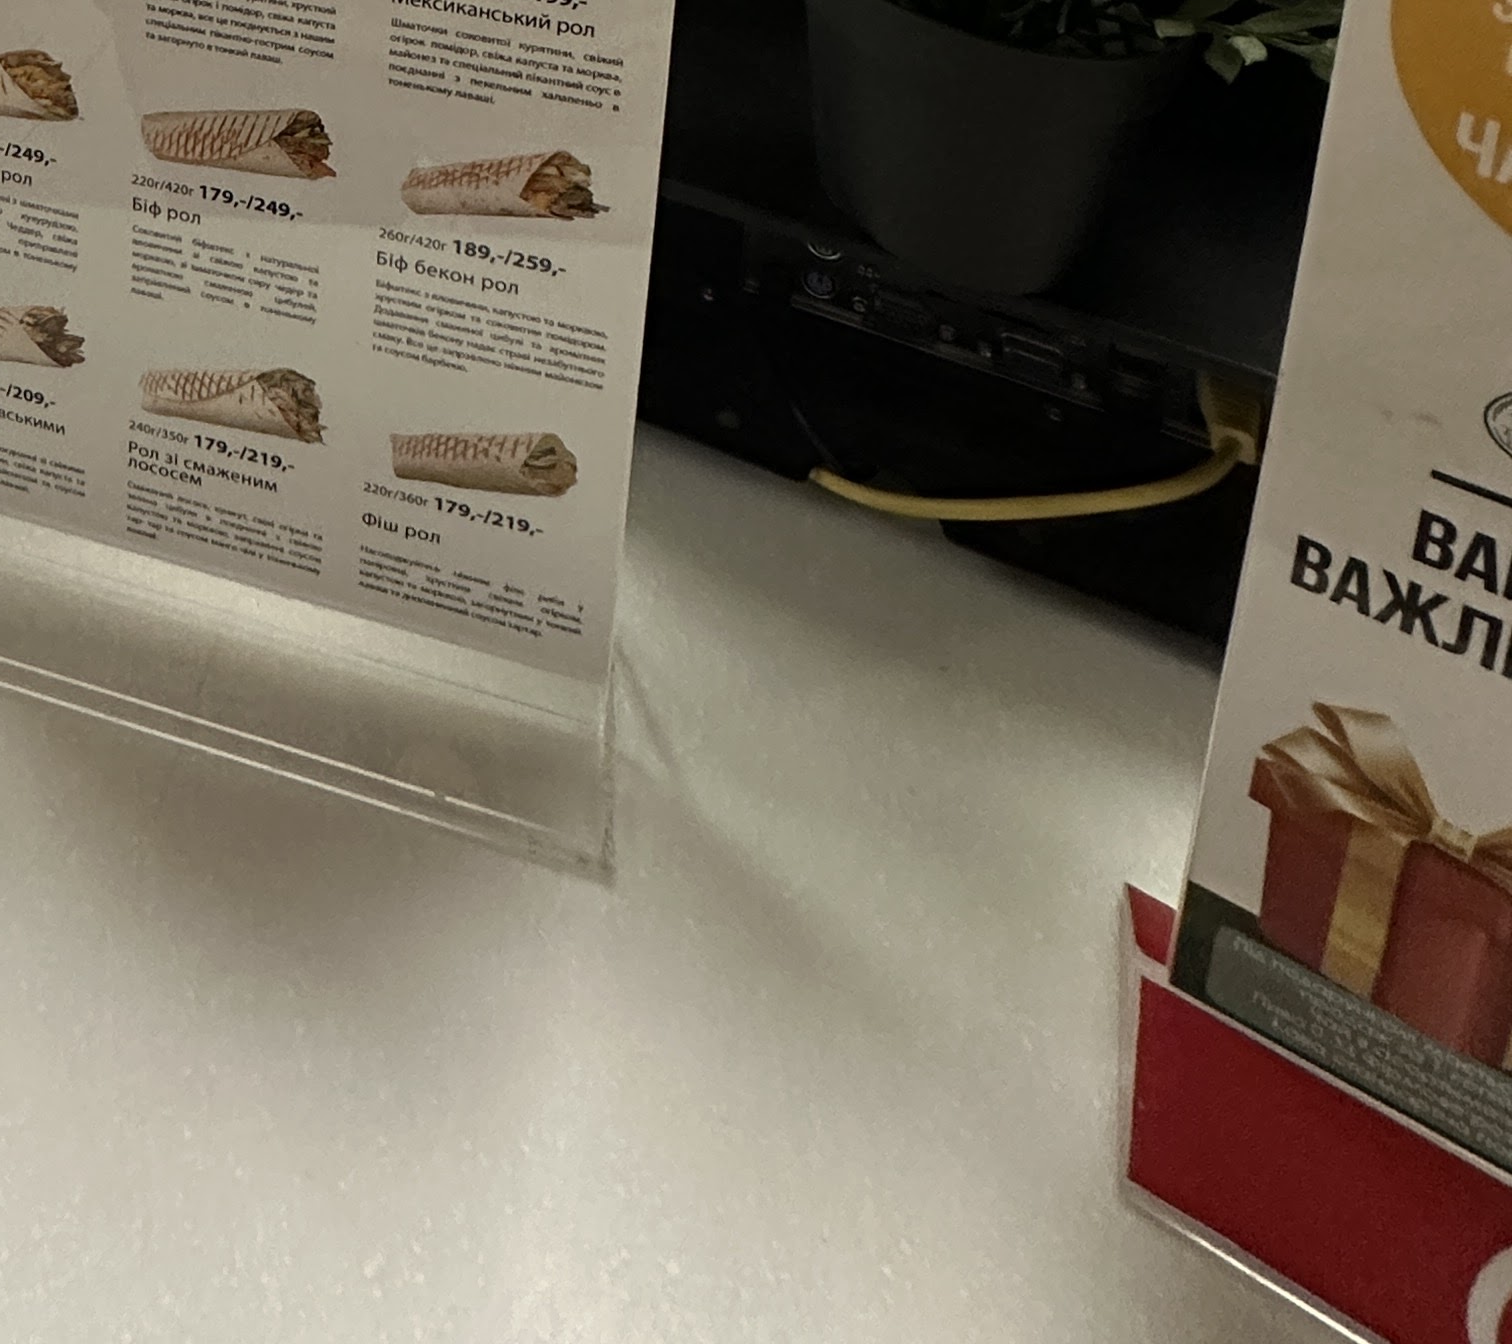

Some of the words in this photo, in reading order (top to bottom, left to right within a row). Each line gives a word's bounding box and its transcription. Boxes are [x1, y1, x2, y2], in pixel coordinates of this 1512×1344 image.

[556, 19, 595, 39] рол
[376, 250, 409, 273] Біф
[414, 258, 475, 286] бекон
[481, 276, 519, 297] рол
[361, 511, 399, 535] Фіш
[404, 524, 441, 545] рол
